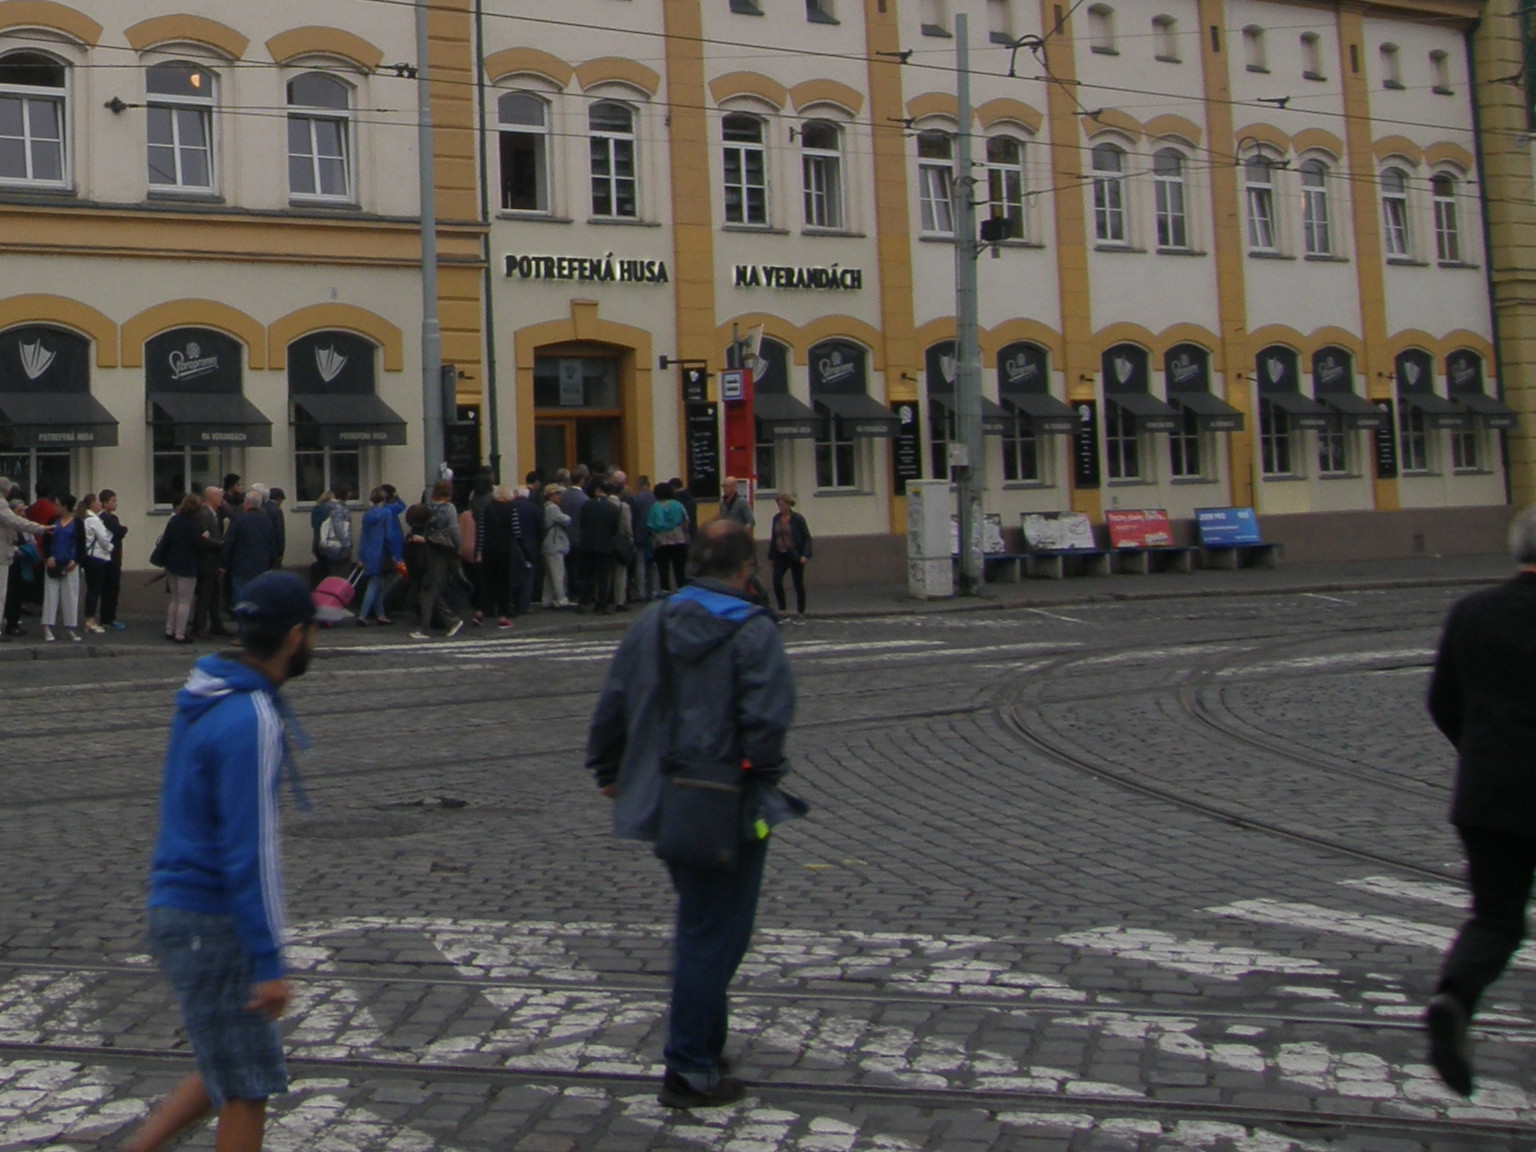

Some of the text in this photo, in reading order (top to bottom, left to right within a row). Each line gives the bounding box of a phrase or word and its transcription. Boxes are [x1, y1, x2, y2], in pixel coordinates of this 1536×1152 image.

[505, 251, 669, 283] POTREFENÁ HUSA
[735, 262, 863, 289] NA VERANDÁCH
